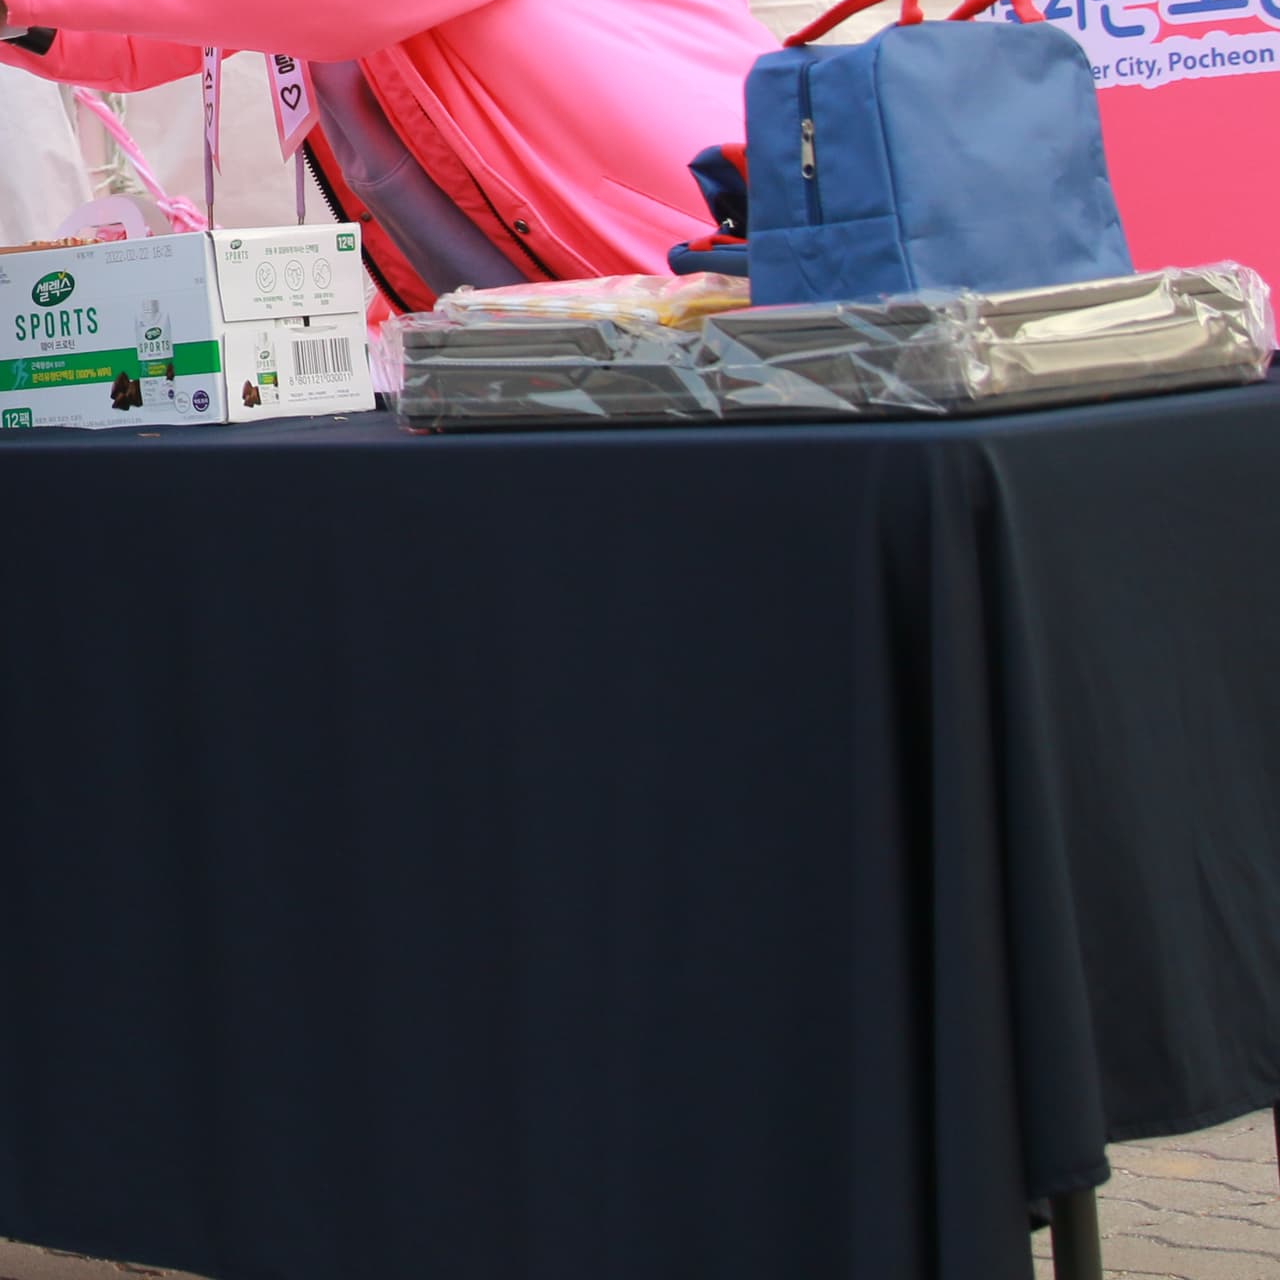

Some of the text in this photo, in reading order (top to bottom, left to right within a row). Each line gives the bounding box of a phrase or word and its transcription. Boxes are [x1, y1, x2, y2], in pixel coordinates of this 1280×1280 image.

[1115, 55, 1162, 81] City,
[1168, 46, 1275, 72] Pocheon
[225, 250, 249, 261] SPORTS
[36, 276, 72, 303] 셀렉스
[15, 306, 99, 341] SPORTS
[139, 340, 170, 354] SPORTS
[289, 372, 352, 386] 8 801121 030011
[4, 411, 31, 428] 12팩
